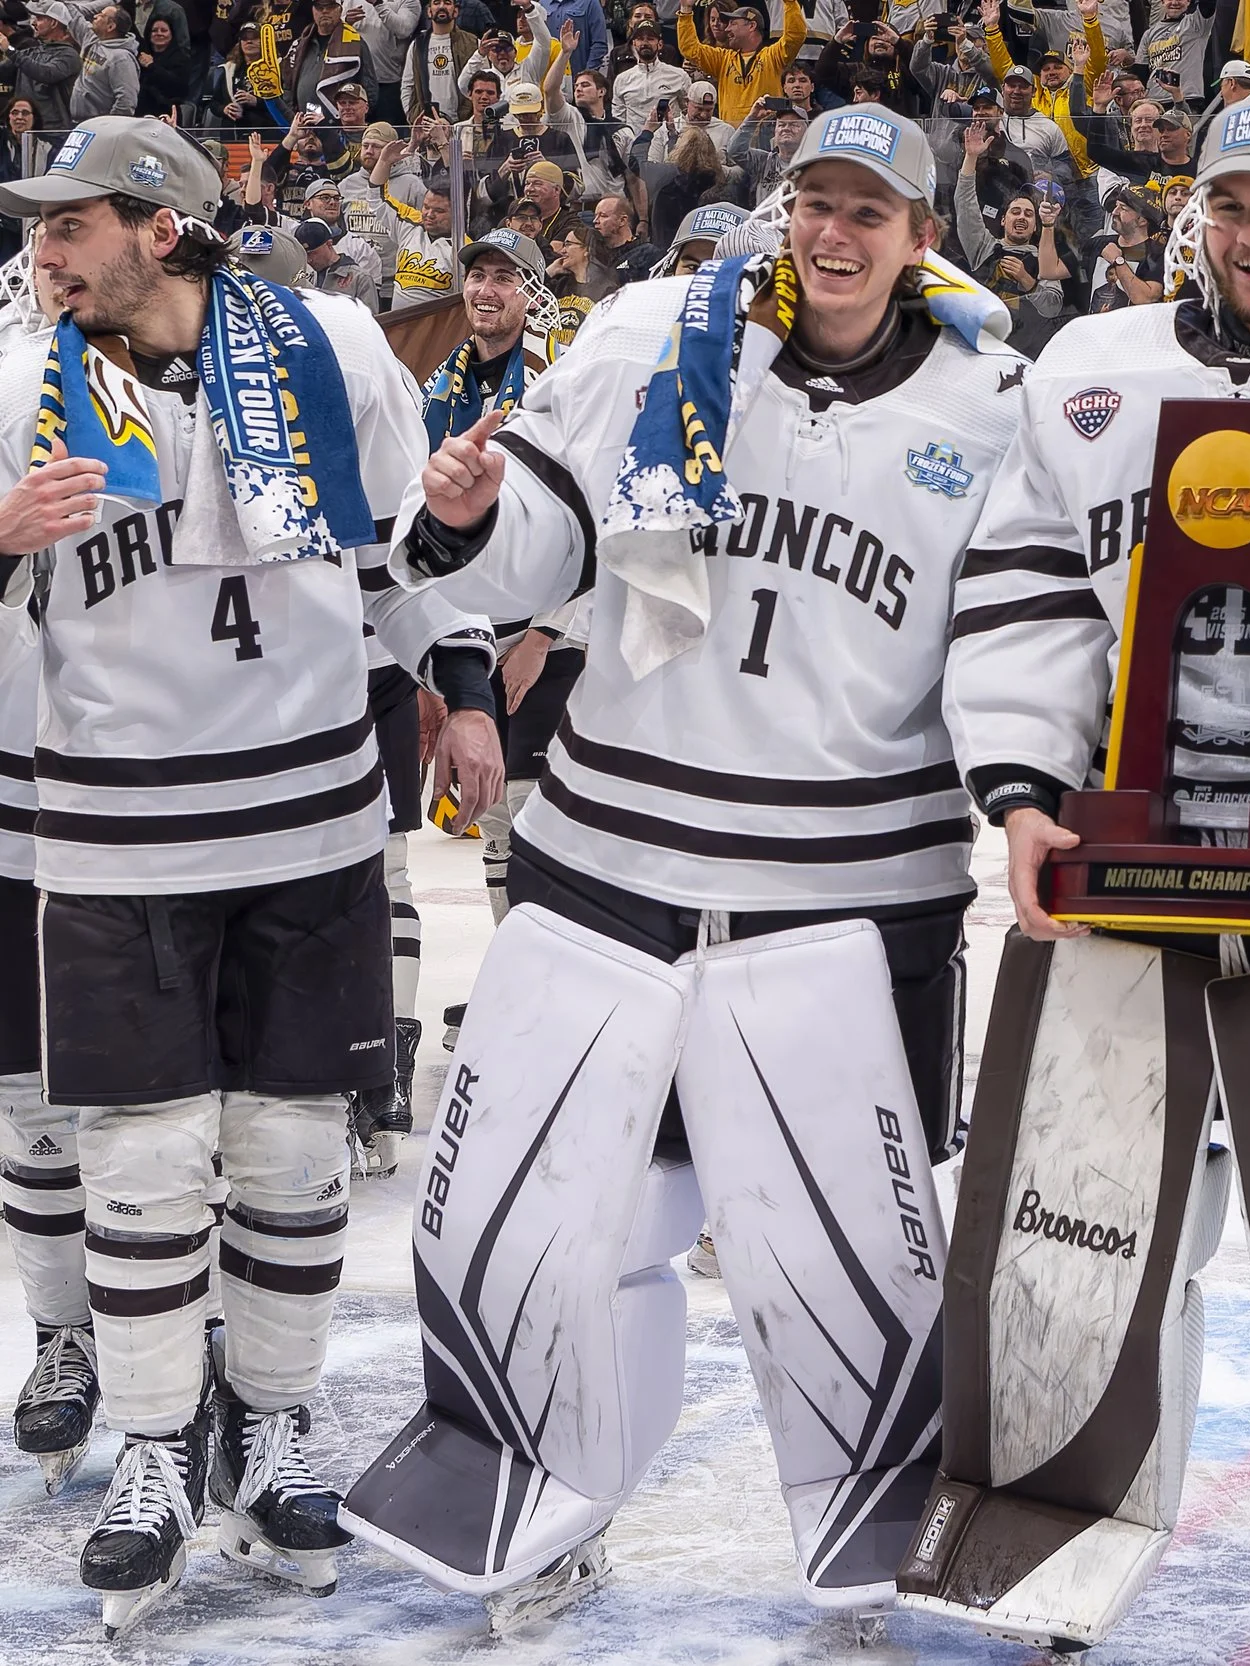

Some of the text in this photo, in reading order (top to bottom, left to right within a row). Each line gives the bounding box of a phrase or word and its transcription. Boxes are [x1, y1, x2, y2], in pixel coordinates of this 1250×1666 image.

[839, 115, 894, 138] NATIONAL
[834, 128, 891, 155] CHAMPIONS
[704, 210, 738, 225] NATIONAL
[397, 248, 453, 285] Western
[685, 274, 718, 332] HOCKEY
[161, 371, 200, 384] adidas
[201, 345, 216, 385] LOUIS
[233, 371, 281, 452] FOUR
[1065, 394, 1121, 415] NCHC
[910, 454, 945, 477] FROZEN
[944, 466, 969, 485] FOUR
[210, 573, 264, 662] 4
[739, 588, 778, 678] 1
[1192, 791, 1213, 803] ICE
[1104, 867, 1184, 890] NATIONAL
[349, 1036, 387, 1053] BAUER
[29, 1145, 63, 1158] adidas
[421, 1063, 480, 1240] BAUER
[874, 1103, 938, 1282] BAUER
[106, 1203, 143, 1217] adidas
[1012, 1188, 1137, 1260] Broncos
